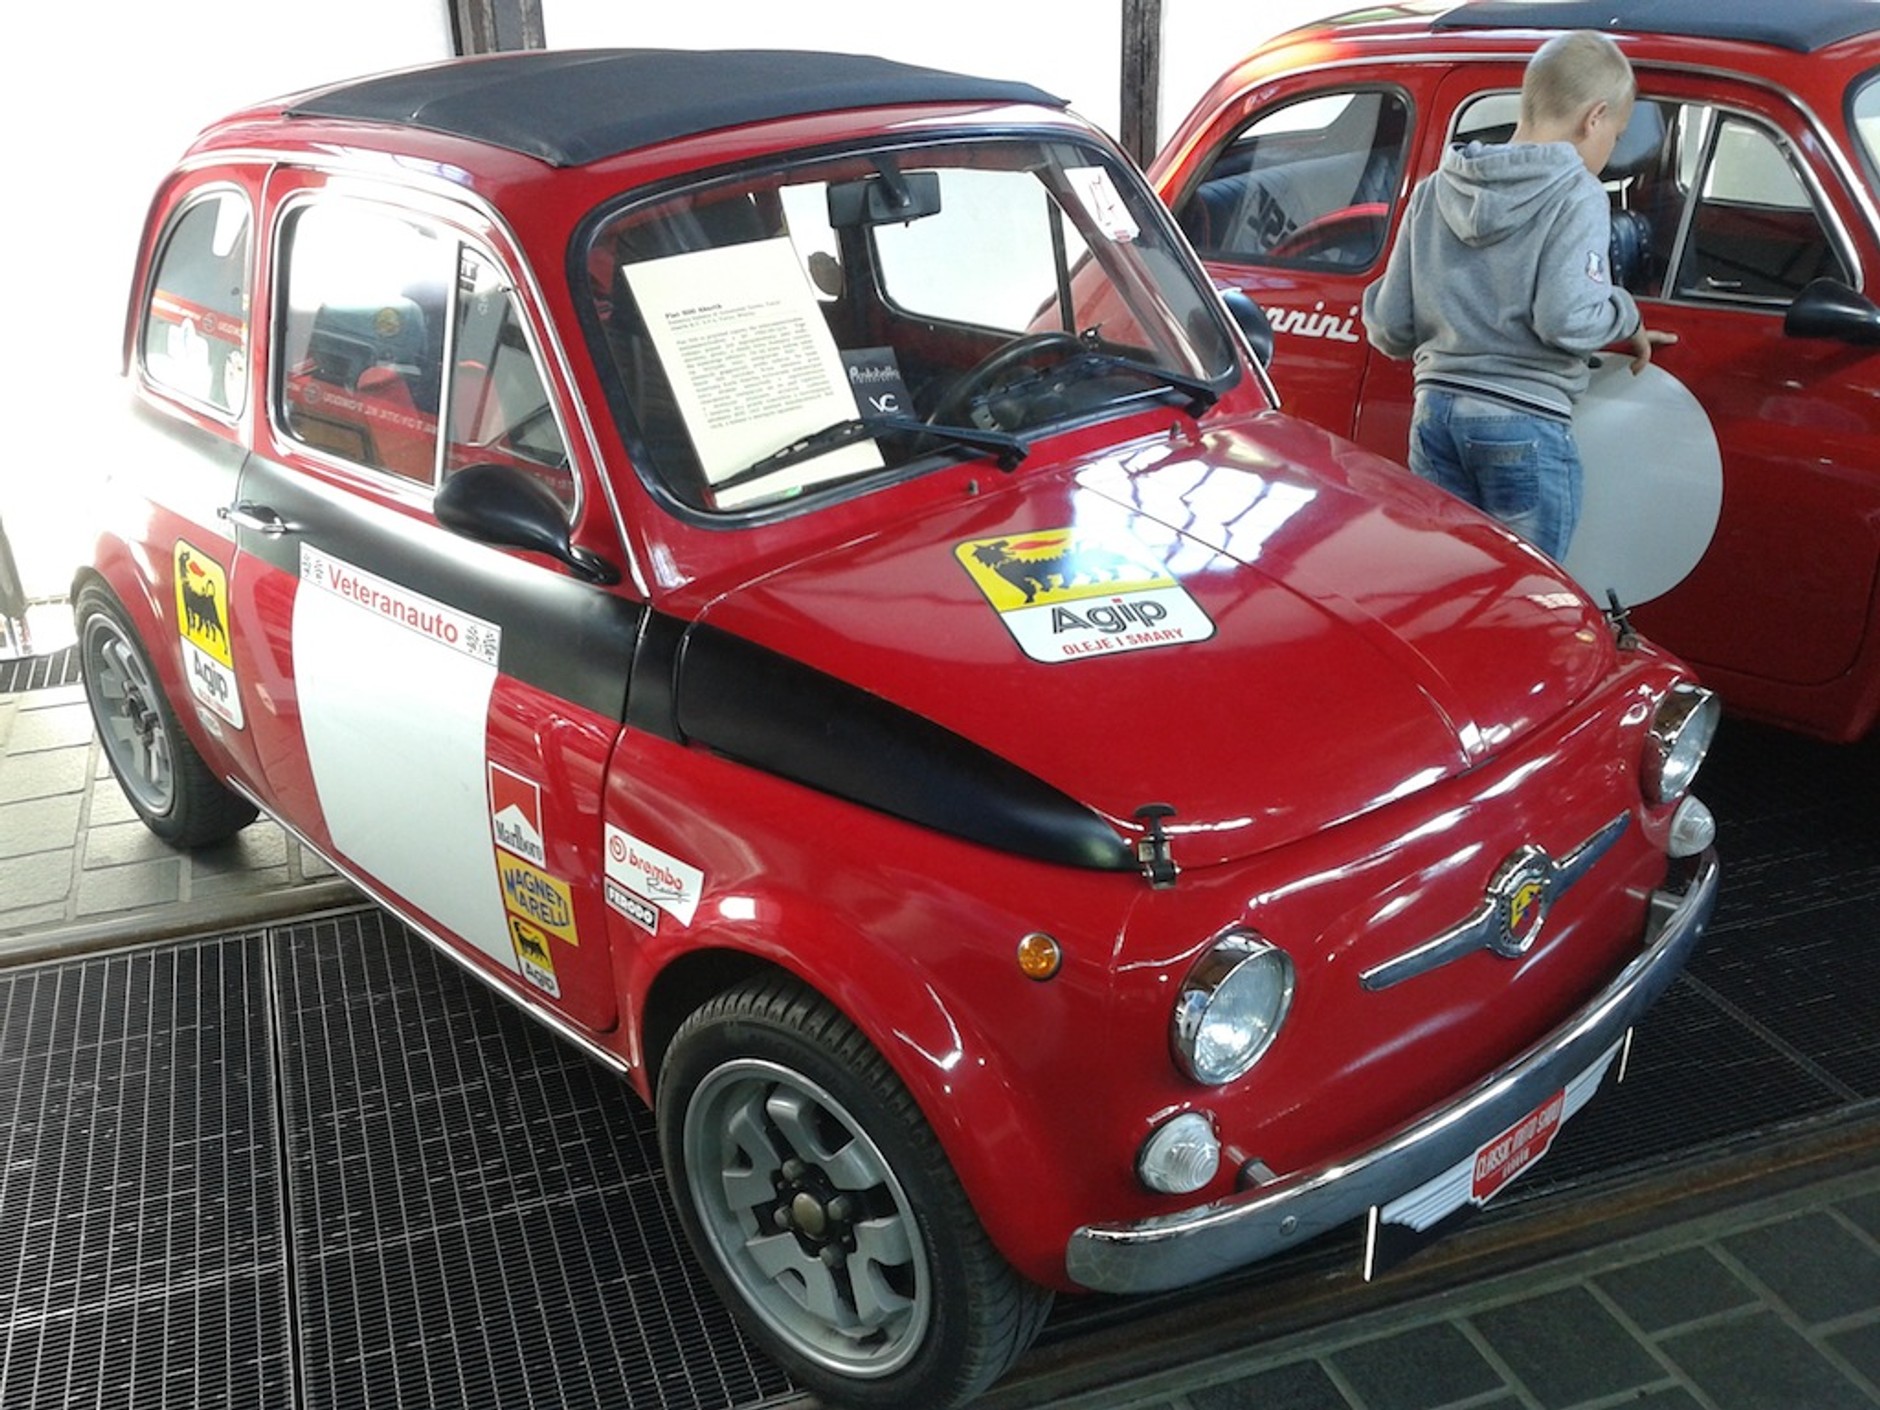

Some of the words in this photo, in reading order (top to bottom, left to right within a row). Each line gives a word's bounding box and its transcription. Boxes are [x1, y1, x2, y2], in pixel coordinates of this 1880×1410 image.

[328, 564, 459, 644] Veteranauto
[1051, 597, 1168, 635] Agip
[1061, 636, 1115, 656] OLEJE
[1115, 635, 1124, 647] I
[1127, 627, 1185, 645] SMARY
[193, 649, 229, 703] Agip
[629, 847, 684, 890] brembo
